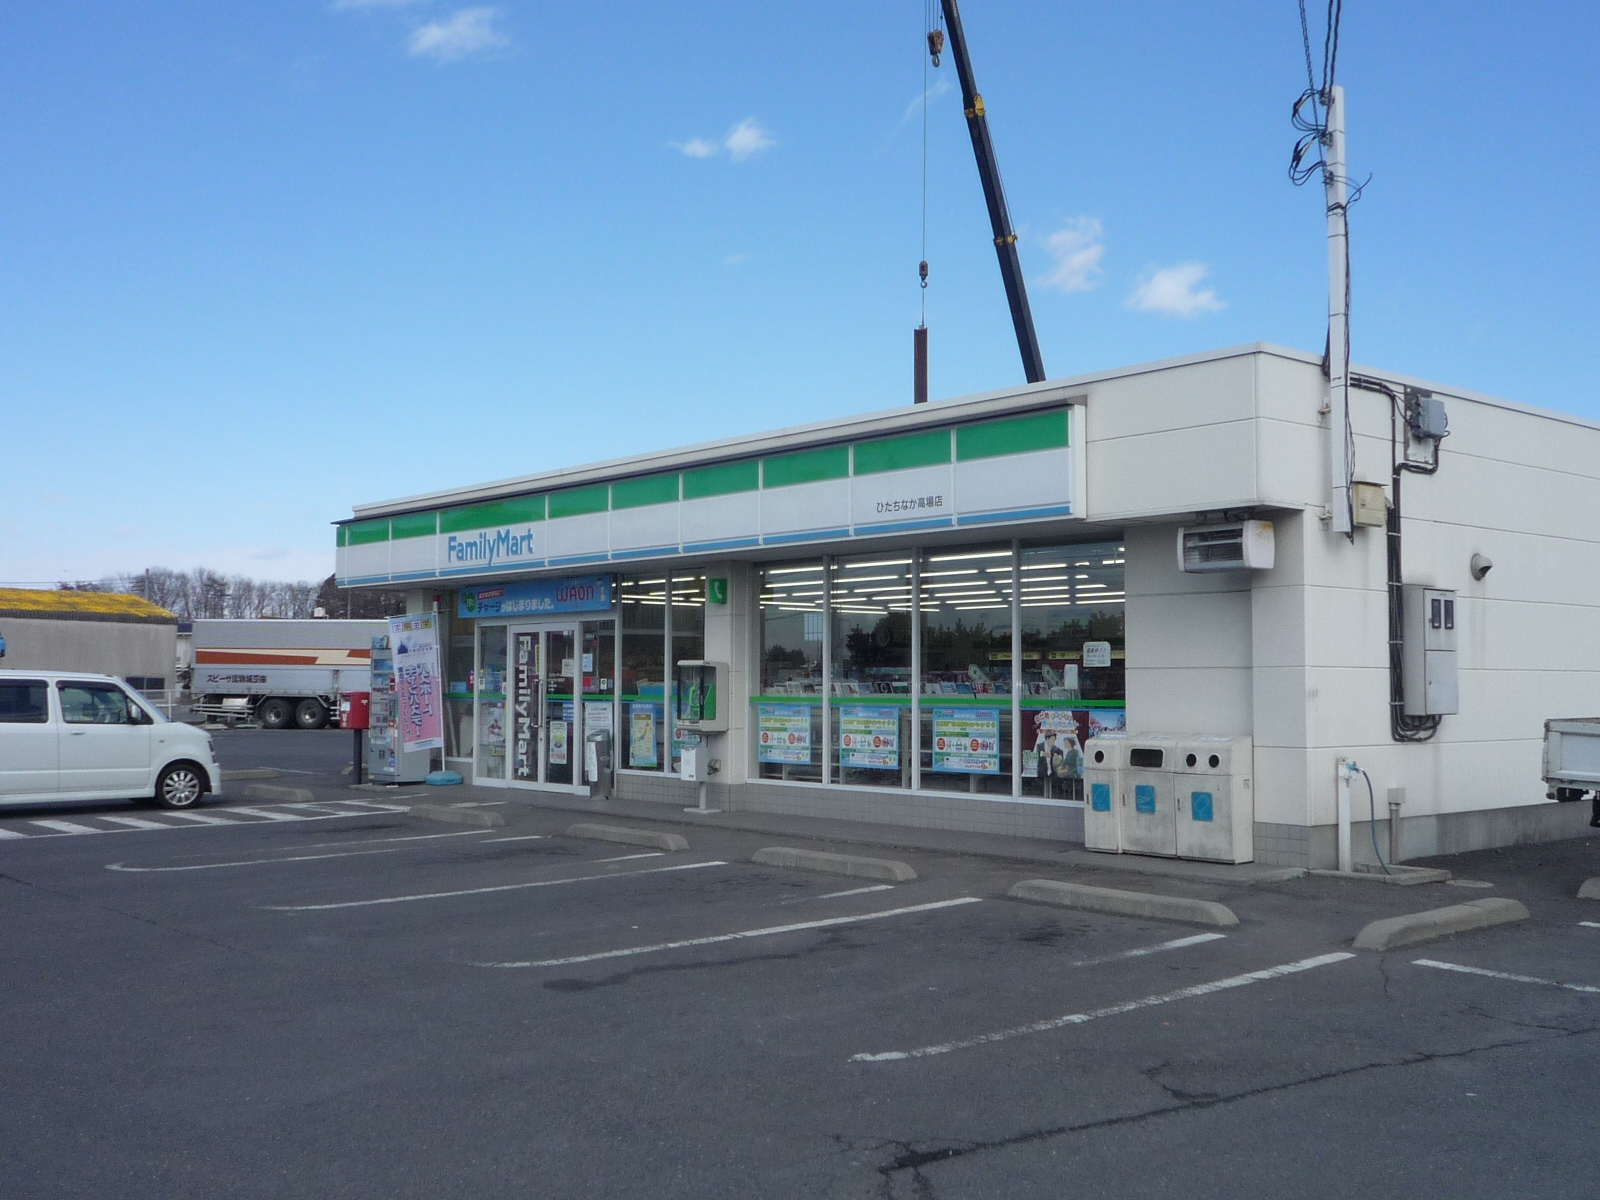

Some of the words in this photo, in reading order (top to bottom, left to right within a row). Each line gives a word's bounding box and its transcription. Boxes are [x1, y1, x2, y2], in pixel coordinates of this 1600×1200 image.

[876, 495, 943, 513] ひたちなか高場店
[448, 528, 534, 567] FamilyMart
[516, 636, 531, 776] FamilyMart
